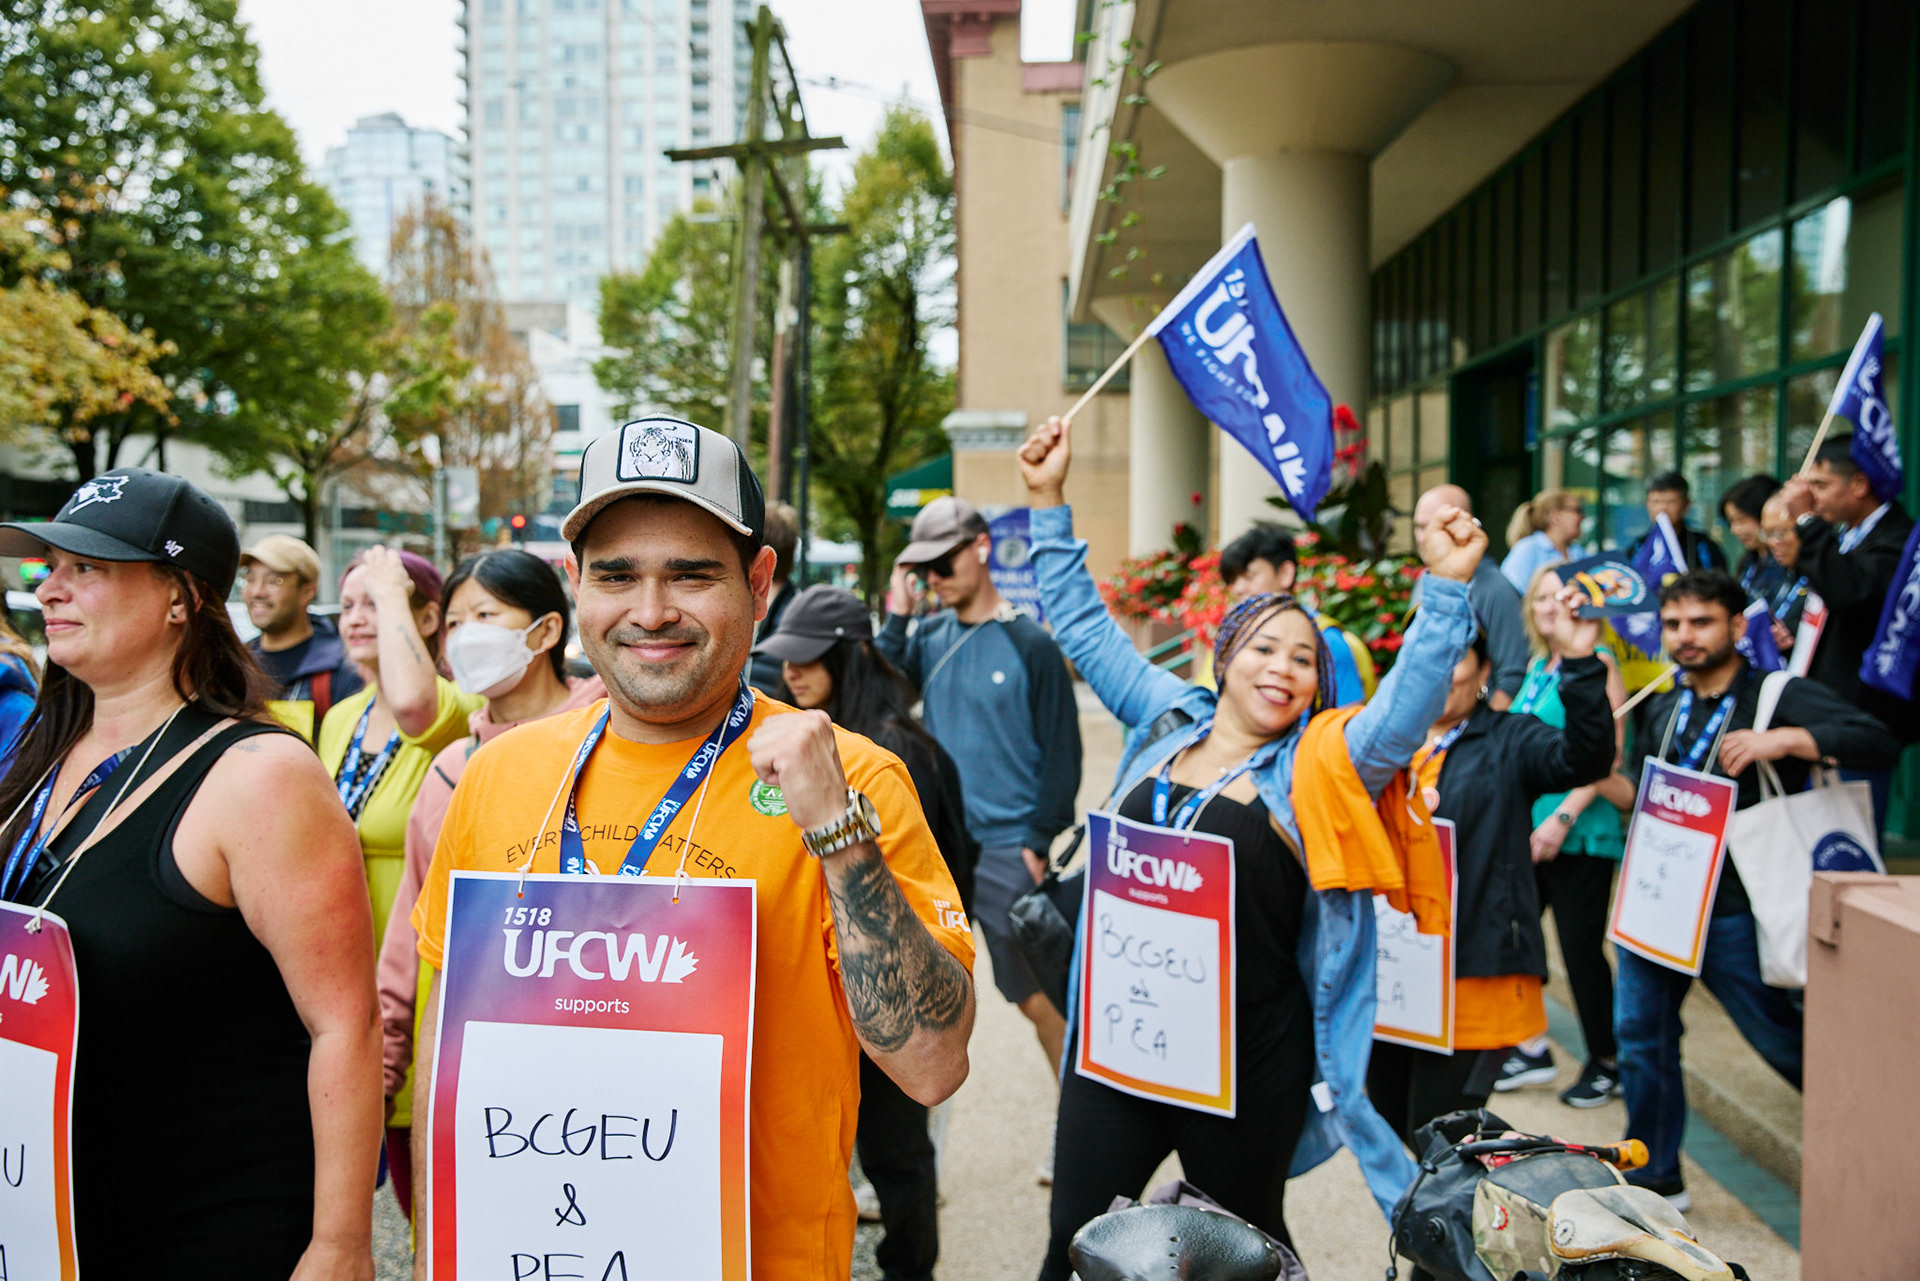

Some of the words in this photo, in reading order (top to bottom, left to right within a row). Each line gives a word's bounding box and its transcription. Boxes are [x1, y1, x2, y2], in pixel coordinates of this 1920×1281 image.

[1195, 348, 1236, 388] FIGHT
[688, 742, 718, 776] UFCW
[646, 799, 677, 836] UFCW
[507, 829, 562, 864] EVER
[581, 823, 639, 842] CHILD
[659, 834, 737, 879] ATTERS
[1107, 843, 1187, 890] UFCW
[504, 907, 552, 926] 1518
[503, 929, 669, 982] UFCW
[1101, 913, 1206, 984] BCGEU
[555, 998, 630, 1014] supports
[1104, 1003, 1167, 1060] PEA
[484, 1107, 677, 1161] BCGEU
[555, 1183, 586, 1227] &
